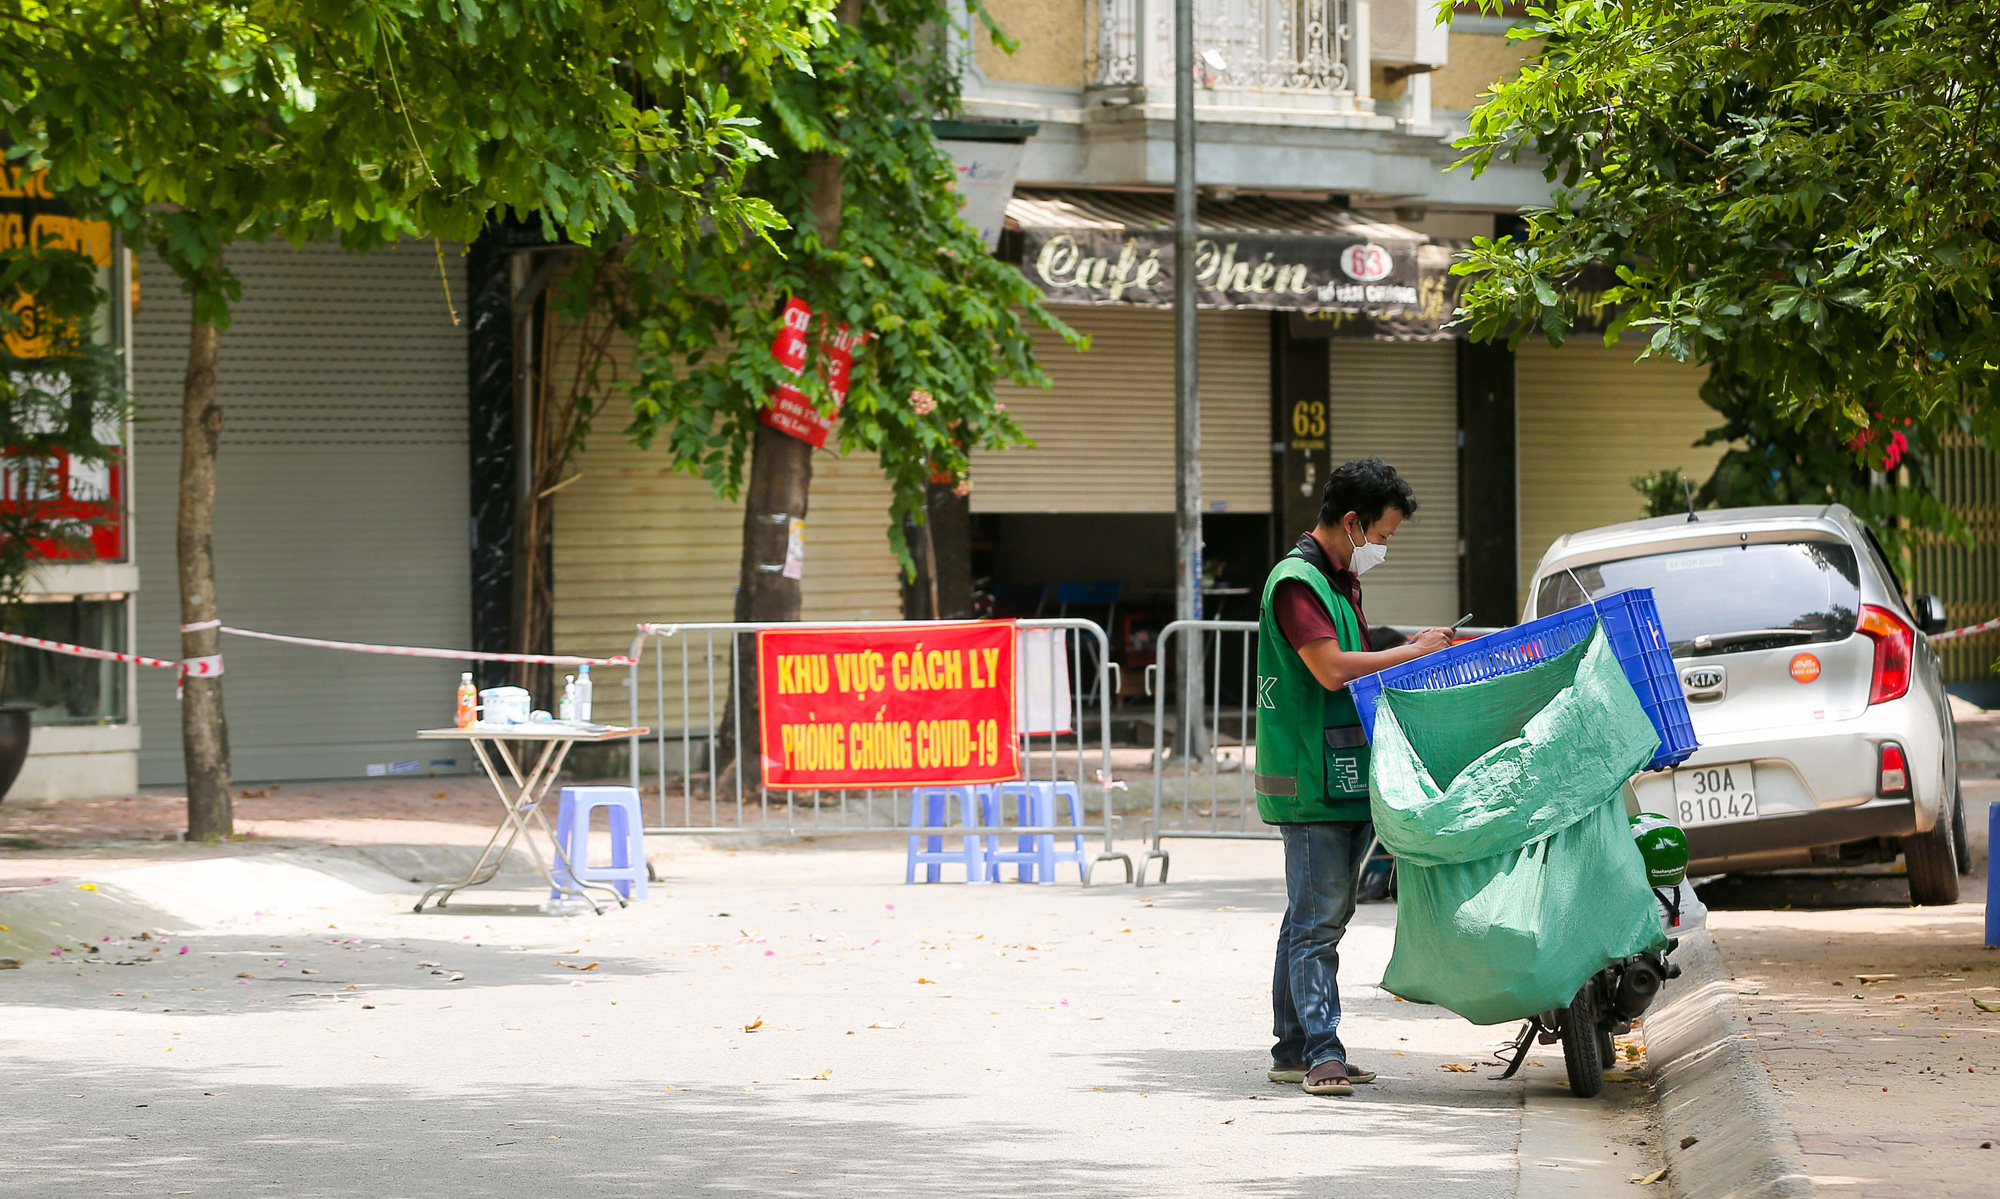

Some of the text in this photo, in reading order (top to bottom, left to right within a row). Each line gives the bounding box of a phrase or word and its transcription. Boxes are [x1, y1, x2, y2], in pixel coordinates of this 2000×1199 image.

[1036, 234, 1164, 300] Café
[1352, 246, 1384, 277] 63
[1293, 401, 1326, 436] 63
[777, 642, 1000, 701] KHU VỰC CÁCH LY
[1690, 673, 1717, 687] KIA
[781, 703, 999, 771] PHÒNG CHỐNG COVID-19
[1692, 768, 1735, 795] 30A
[1679, 792, 1755, 824] 810.42
